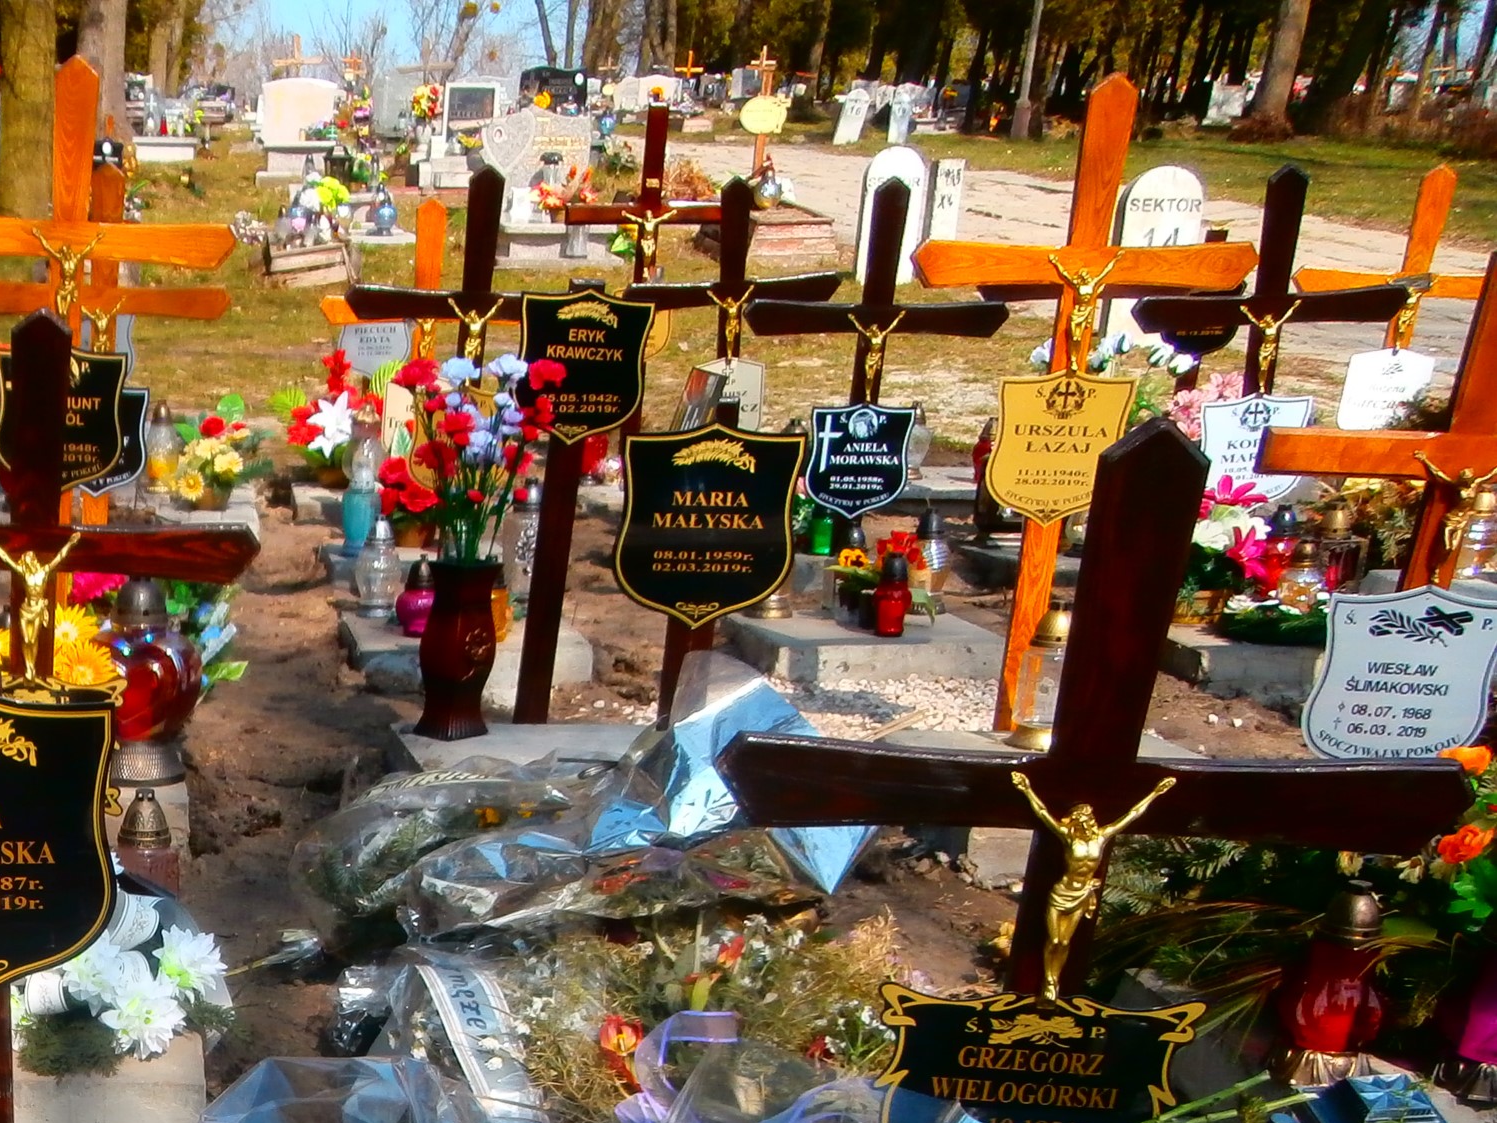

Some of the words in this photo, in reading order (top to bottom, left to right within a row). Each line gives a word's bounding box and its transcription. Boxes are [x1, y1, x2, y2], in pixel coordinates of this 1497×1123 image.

[1129, 197, 1202, 213] SEKTOR
[1144, 227, 1180, 248] 14
[569, 328, 605, 343] ERYK
[546, 345, 623, 361] KRAWCZYK
[1014, 424, 1108, 438] URSZULA
[843, 443, 888, 452] ANIELA
[1025, 441, 1091, 454] ŁAZAJ
[830, 455, 899, 464] MORAWSKA
[1017, 469, 1089, 478] 11.11.1940r.
[1015, 478, 1088, 486] 28.02.2019r.
[672, 491, 748, 507] MARIA
[1004, 490, 1050, 507] SPOCZYWAJ
[652, 512, 764, 529] MAŁYSKA
[654, 551, 753, 561] 08.01.1959r.
[653, 563, 752, 573] 02.03.2019r.
[1344, 610, 1357, 625] Ś.
[1481, 618, 1493, 630] P.
[1367, 662, 1438, 676] WIESŁAW
[1345, 676, 1448, 696] ŚLIMAKOWSKI
[1316, 729, 1384, 758] SPOCZYWAJ
[1406, 734, 1463, 758] POKOJU
[965, 1017, 983, 1033] Ś.
[1089, 1027, 1105, 1039] P.
[958, 1045, 1104, 1076] GRZEGORZ
[932, 1076, 1119, 1110] WIELOGÓRSKI
